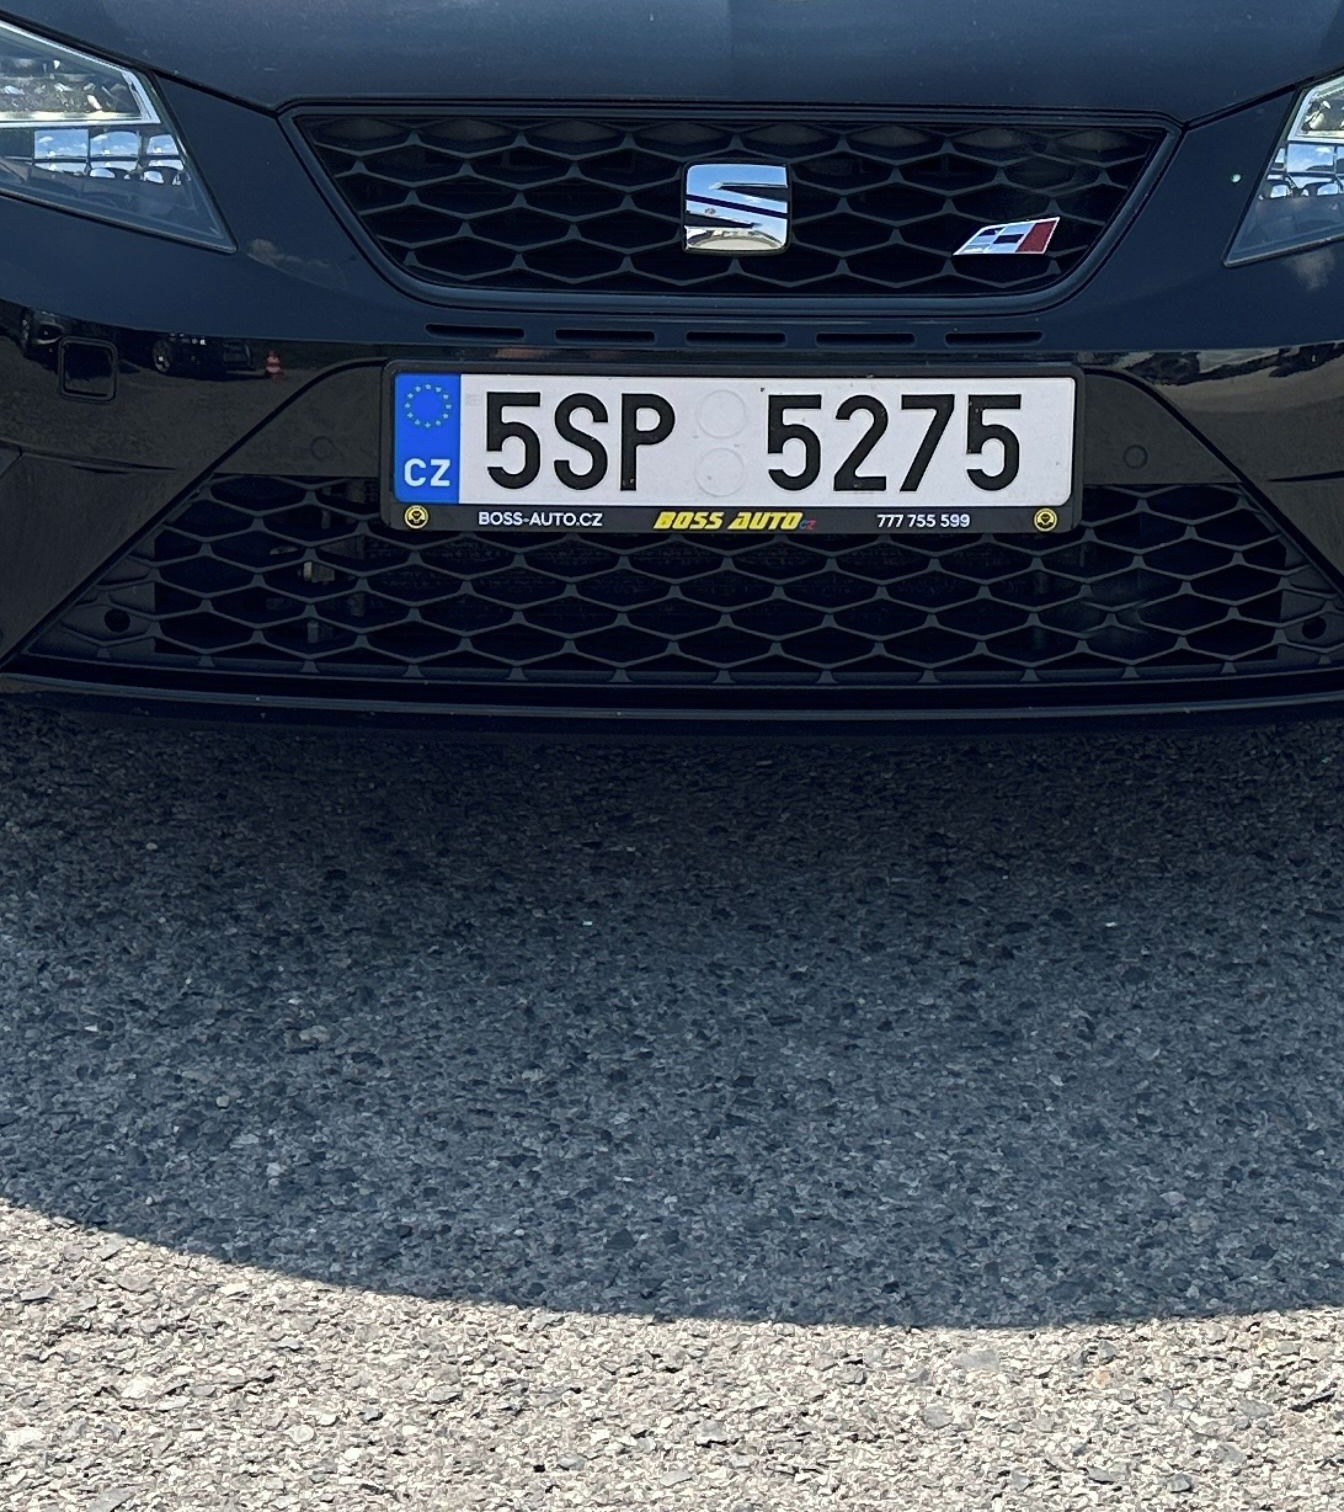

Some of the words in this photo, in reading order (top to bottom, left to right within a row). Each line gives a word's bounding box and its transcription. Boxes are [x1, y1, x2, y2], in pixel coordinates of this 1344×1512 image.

[485, 391, 676, 491] 5SP
[766, 393, 1023, 493] 5275
[403, 457, 452, 487] CZ
[477, 510, 604, 528] BOSS-AUTO.CZ
[653, 511, 725, 530] BOSS
[727, 511, 804, 530] AUTO
[876, 513, 904, 528] 777
[907, 513, 937, 528] 755
[939, 513, 972, 528] 599
